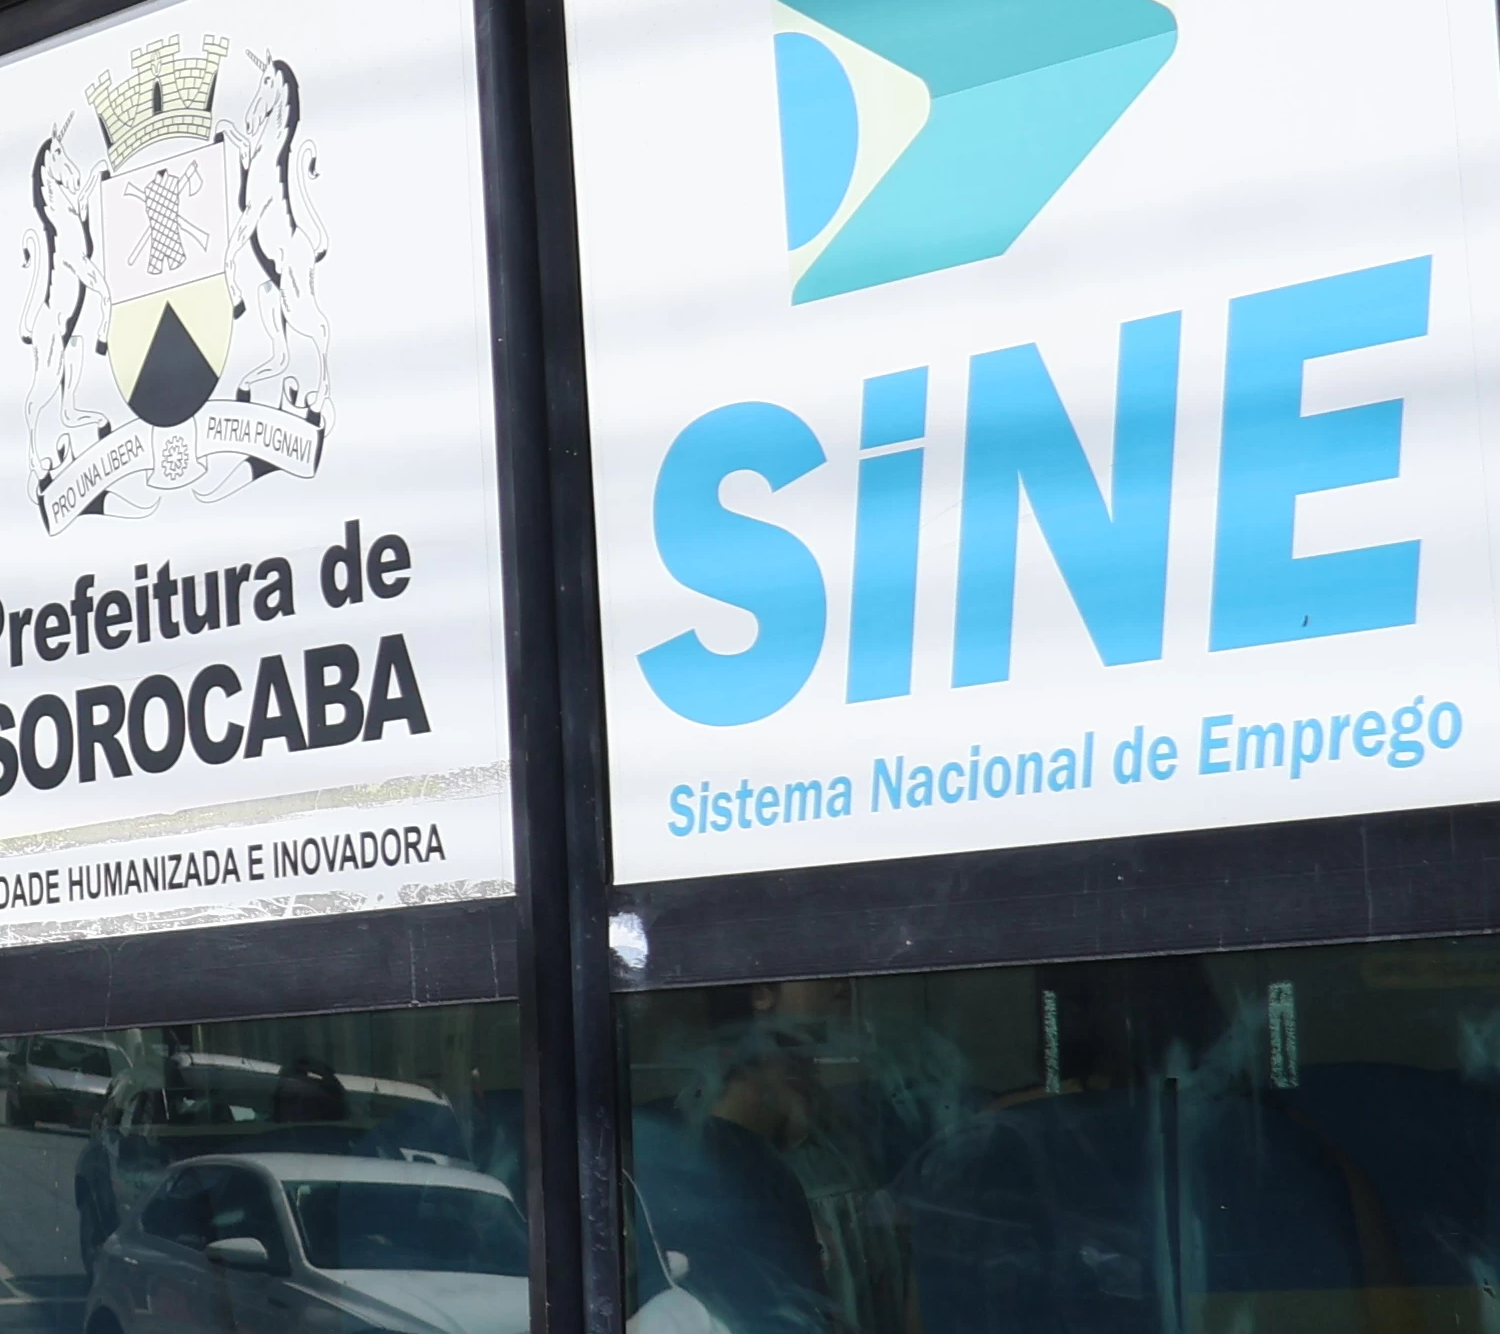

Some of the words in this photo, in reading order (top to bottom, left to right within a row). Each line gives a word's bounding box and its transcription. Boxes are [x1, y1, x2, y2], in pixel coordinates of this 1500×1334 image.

[51, 486, 77, 524] PRO
[77, 463, 102, 495] UNA
[103, 434, 145, 477] LIBERA
[206, 416, 251, 443] PATRIA
[254, 420, 312, 464] PUGNAVI
[320, 518, 411, 610] de
[667, 773, 854, 837] Sistema
[871, 731, 1095, 812] Nacional
[1113, 723, 1178, 784] de
[1198, 694, 1464, 781] Emprego
[67, 850, 243, 905] HUMANIZADA
[247, 843, 265, 881] E
[272, 823, 445, 879] INOVADORA
